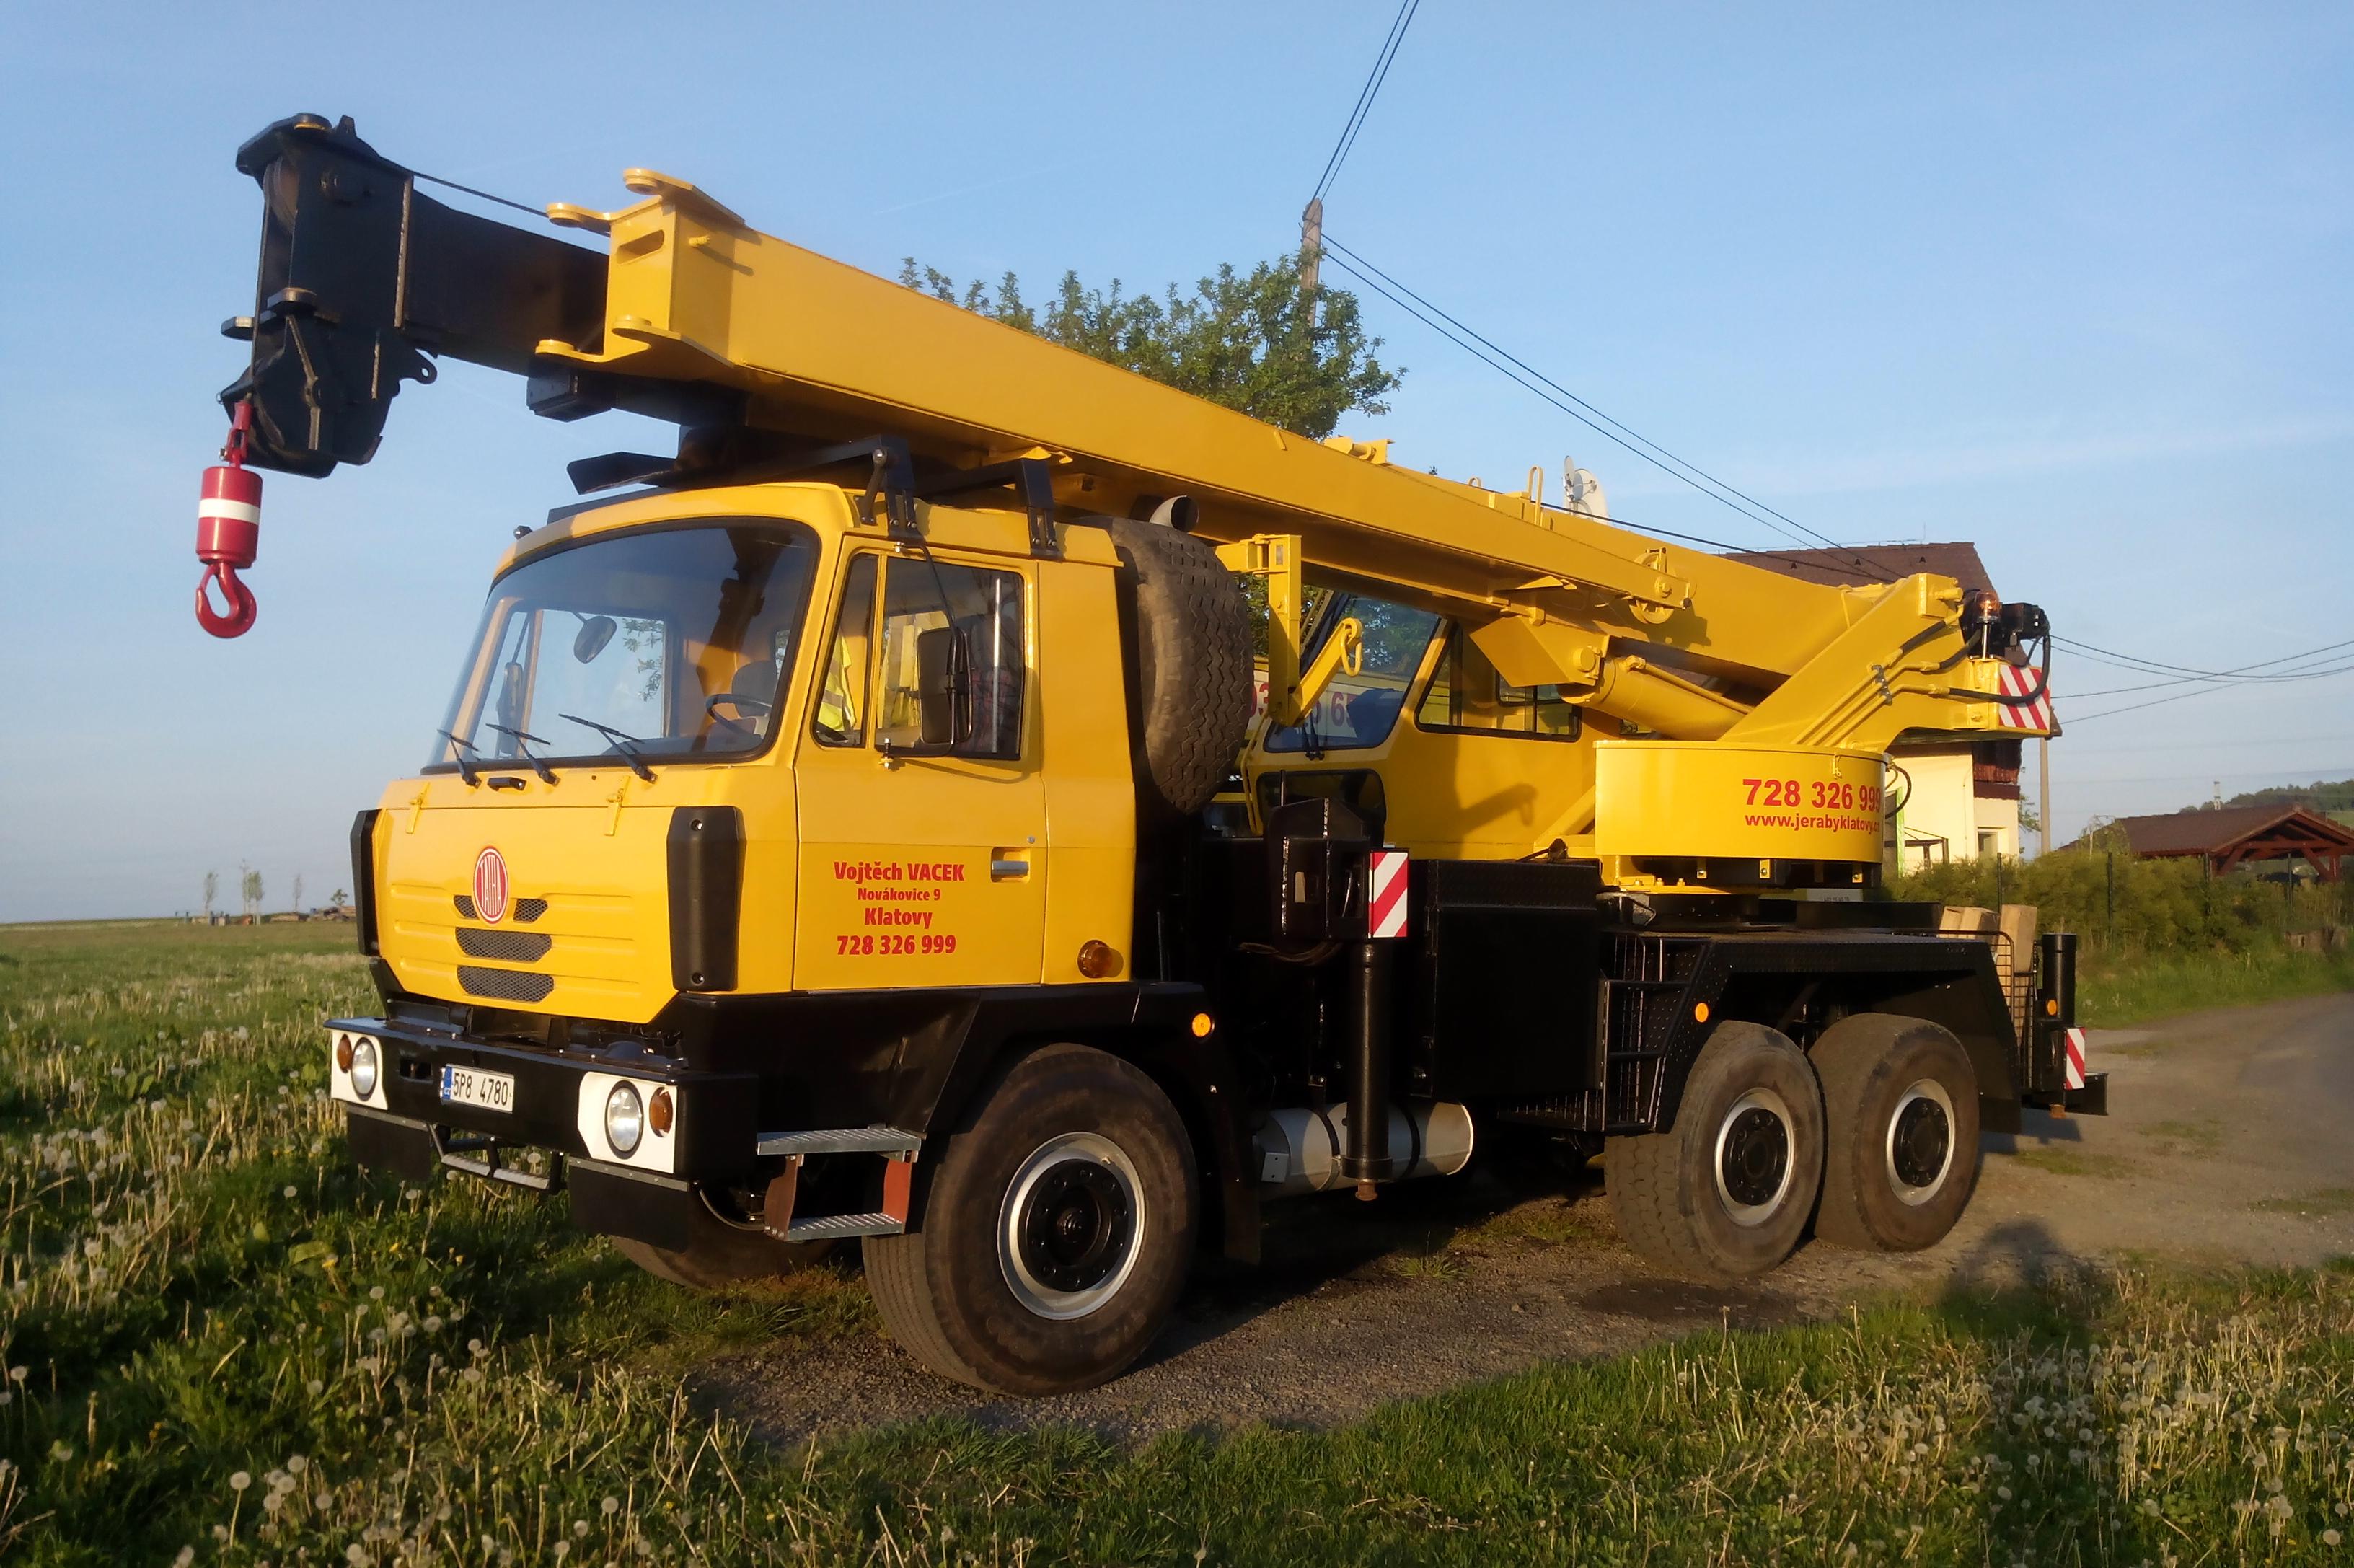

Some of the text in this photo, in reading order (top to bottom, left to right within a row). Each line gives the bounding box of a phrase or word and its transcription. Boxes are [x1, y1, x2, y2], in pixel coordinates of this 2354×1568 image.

[1742, 778, 1881, 813] 728 326 999
[834, 861, 964, 884] Vojtěch VACEK
[480, 854, 502, 916] TATRA
[858, 887, 941, 901] Novákovice 9
[865, 907, 933, 929] Klatovy
[837, 934, 956, 955] 728 326 999
[454, 1072, 508, 1106] 5P8 4780
